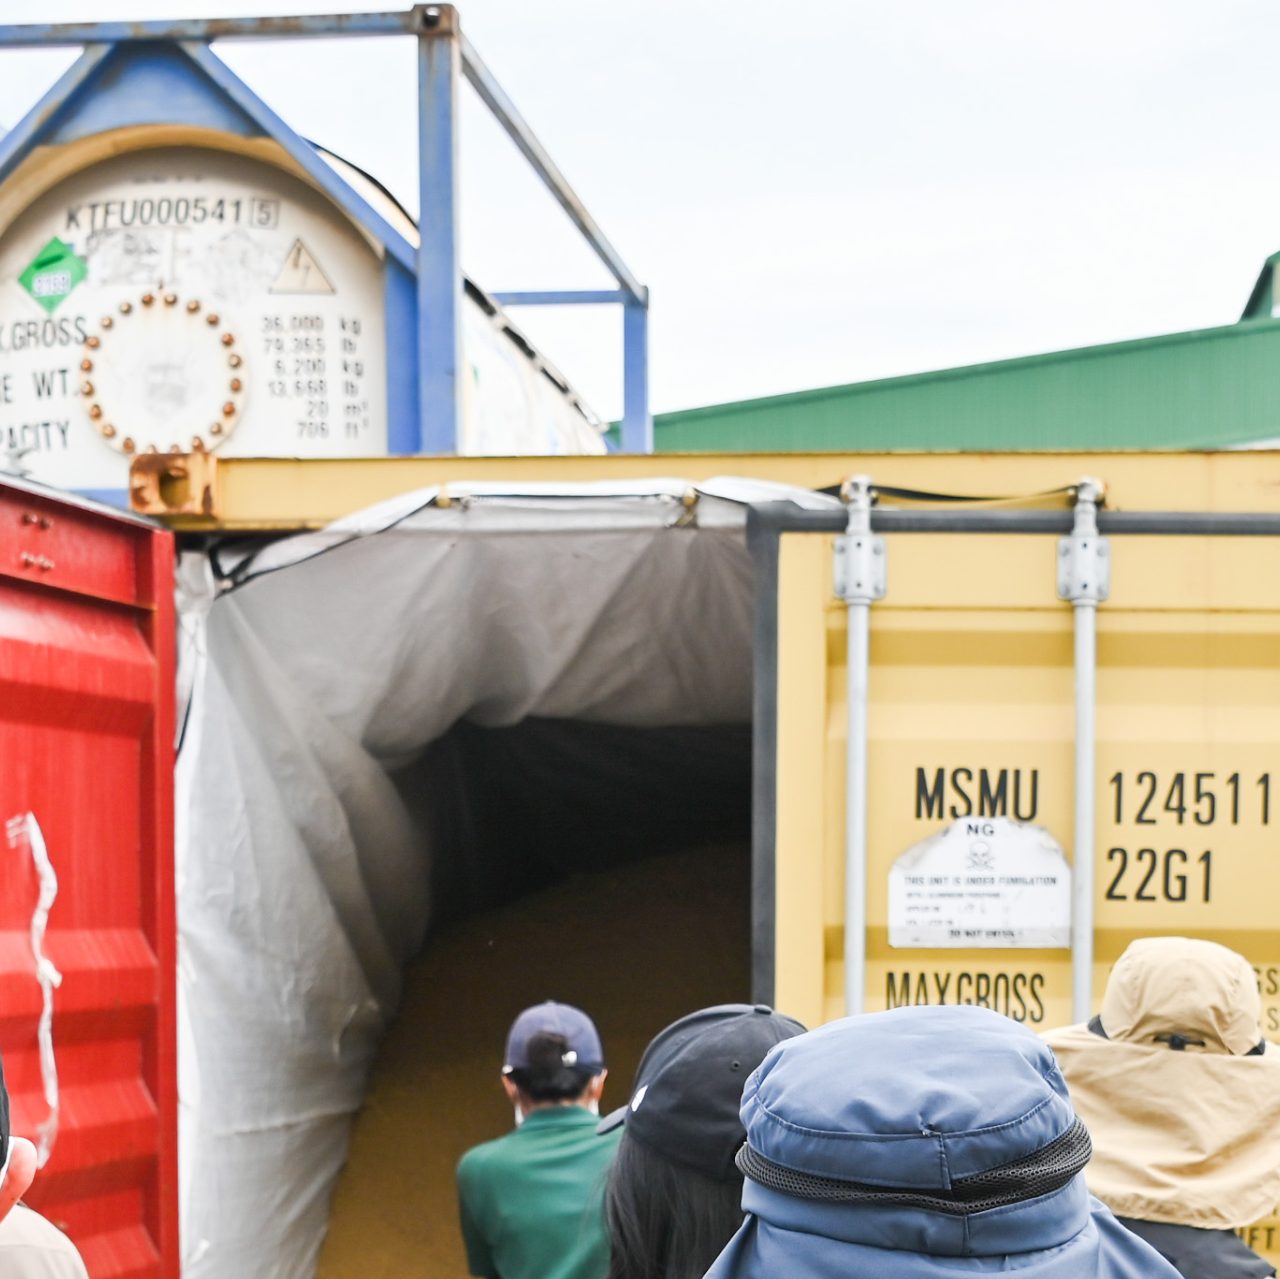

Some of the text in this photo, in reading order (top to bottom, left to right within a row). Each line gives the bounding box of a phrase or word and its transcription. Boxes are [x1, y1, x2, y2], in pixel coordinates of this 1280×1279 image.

[915, 767, 1039, 822] MSMU
[1110, 771, 1272, 826] 124511
[1106, 847, 1212, 903] 22G1
